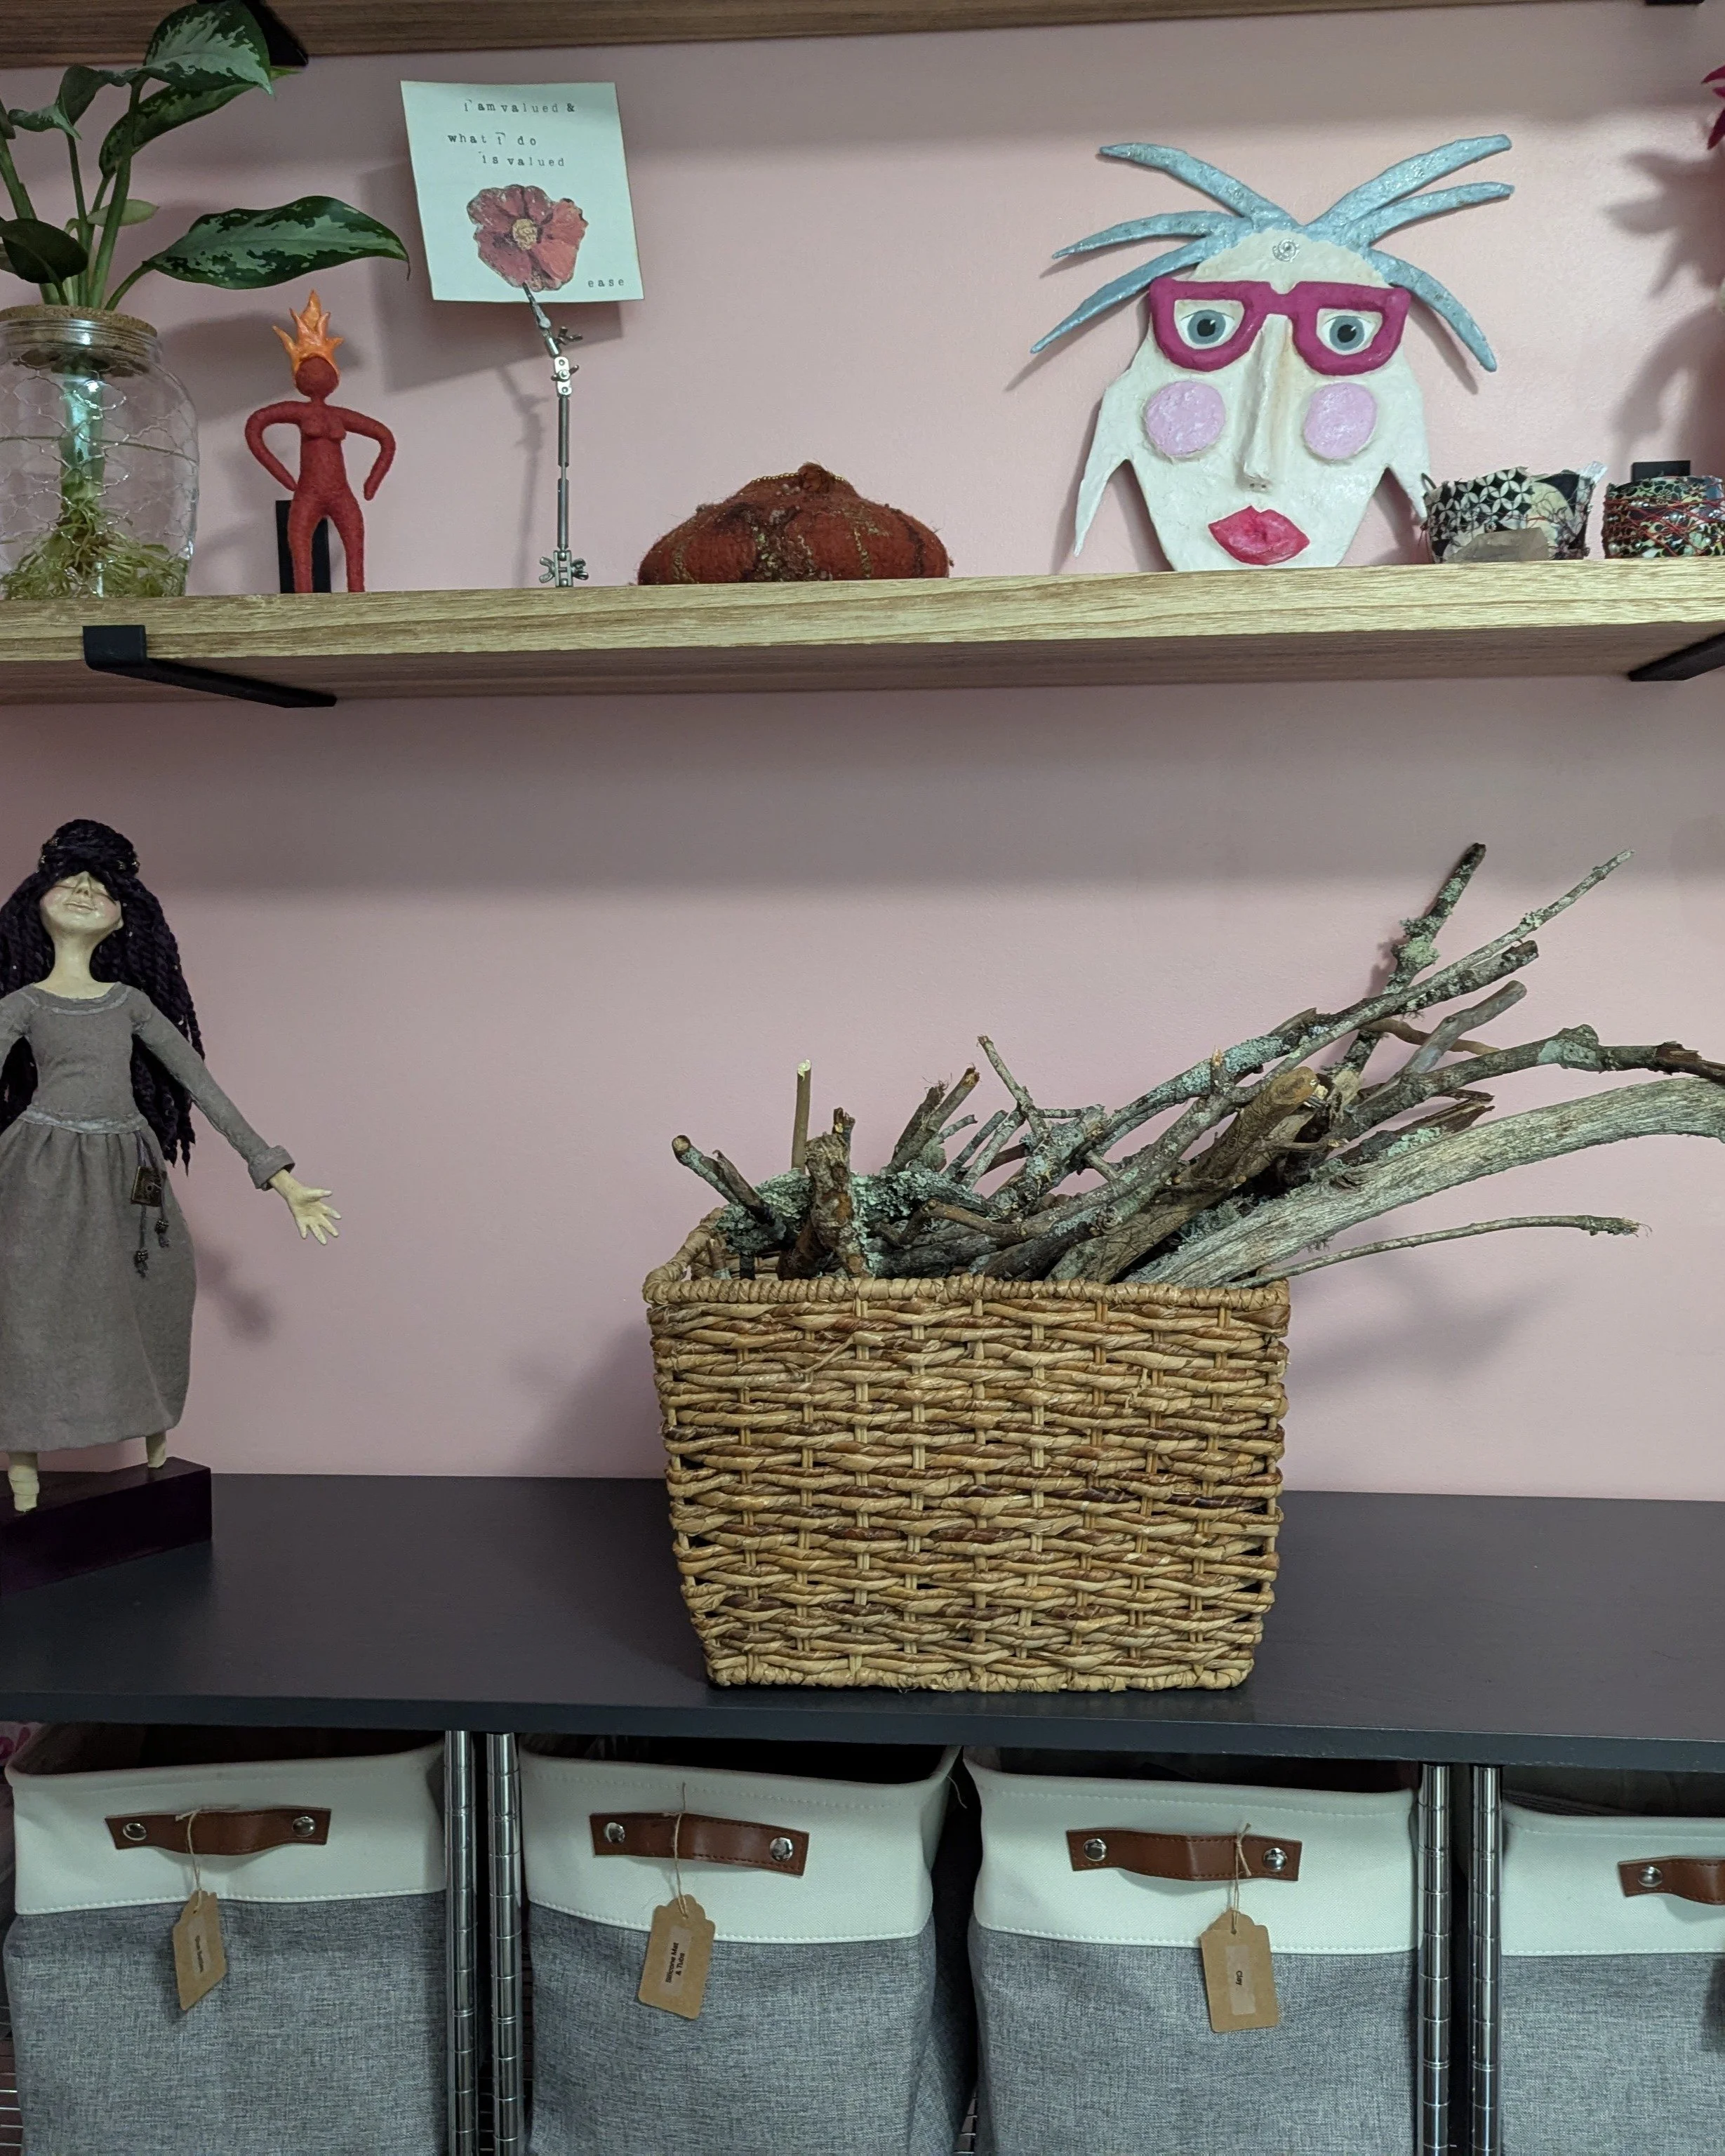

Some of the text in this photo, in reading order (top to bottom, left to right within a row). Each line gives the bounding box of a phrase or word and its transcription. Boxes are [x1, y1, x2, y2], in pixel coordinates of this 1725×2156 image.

[567, 103, 575, 112] &
[448, 133, 487, 144] what
[517, 136, 537, 146] do
[482, 154, 564, 167] is valued
[588, 279, 625, 288] ease
[1235, 1970, 1244, 1986] Clay
